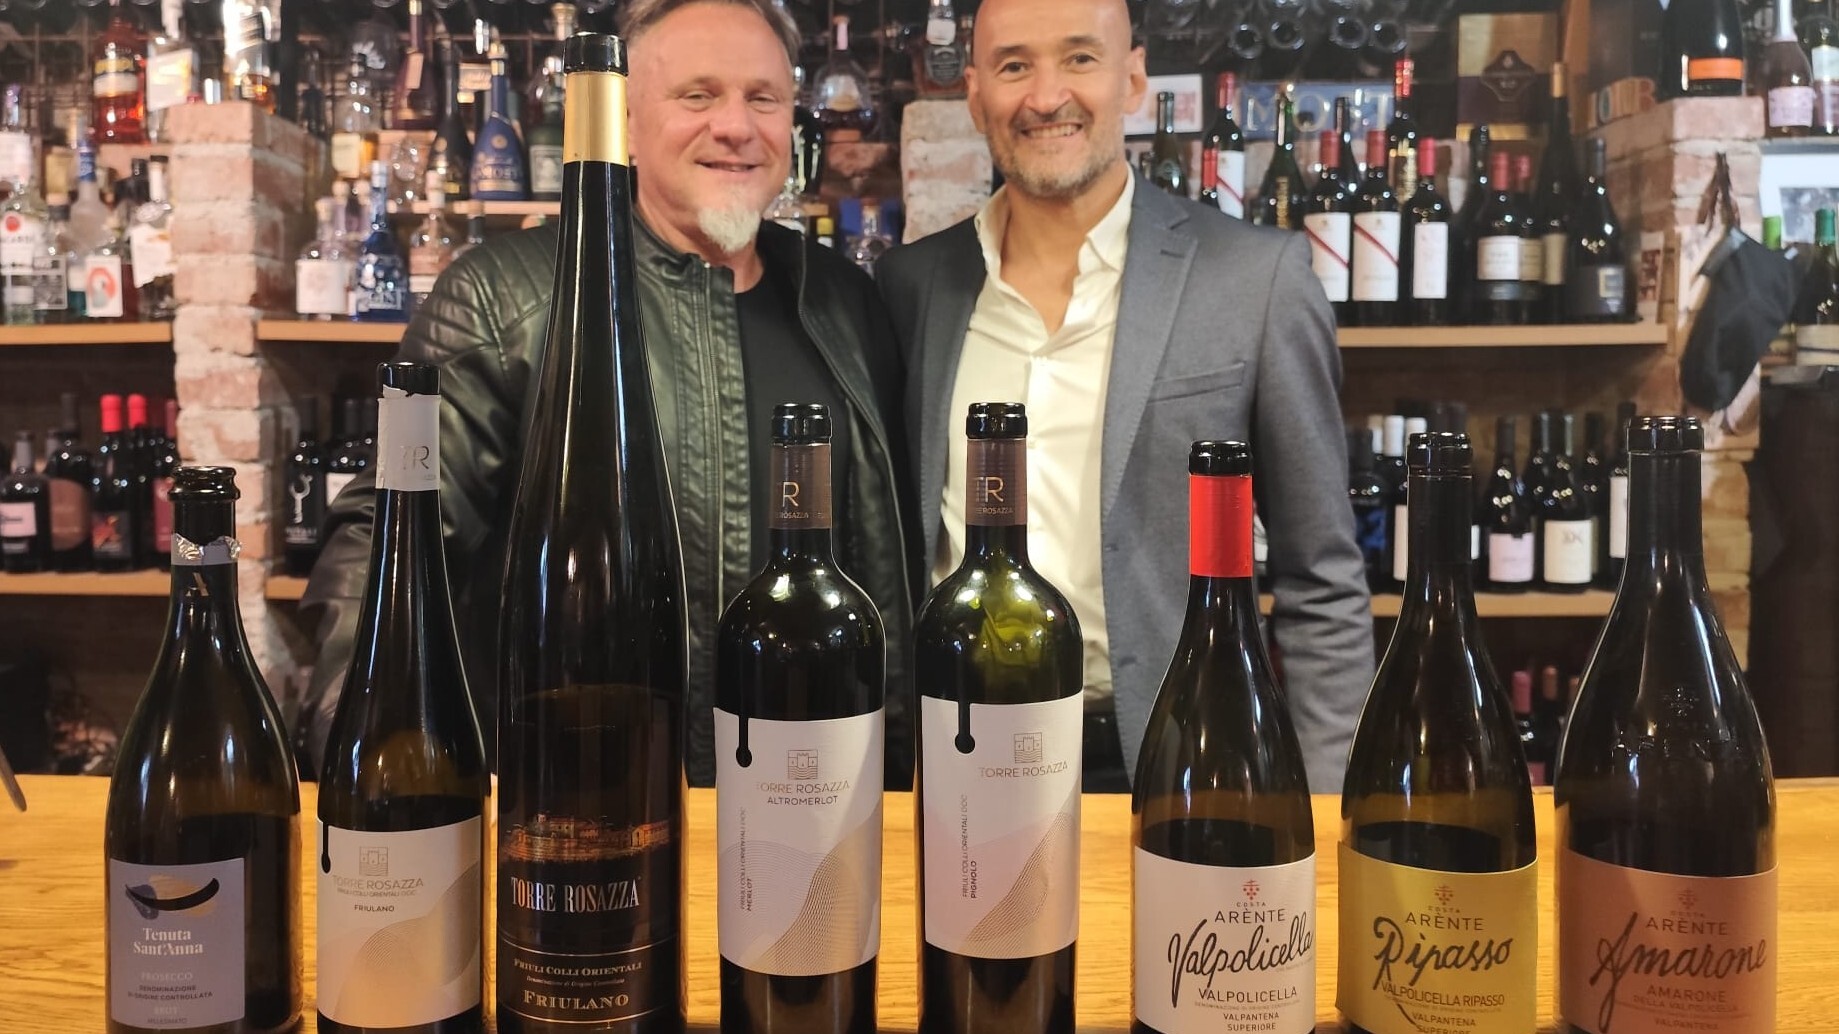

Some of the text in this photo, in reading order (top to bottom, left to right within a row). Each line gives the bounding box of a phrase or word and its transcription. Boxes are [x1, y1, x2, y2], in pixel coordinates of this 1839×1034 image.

[979, 760, 1068, 778] TORRE ROSAZZA
[796, 780, 850, 794] ROSAZZA
[767, 795, 838, 806] ALTROMERLOT
[332, 875, 424, 891] TORRE ROSAZZA
[510, 876, 640, 913] TORRE ROSAZZA
[354, 904, 395, 912] FRIULANO
[1215, 908, 1286, 924] ARÈNTE
[1405, 912, 1485, 931] ARÈNTE
[1645, 917, 1728, 936] ARÈNTE
[143, 928, 191, 941] Tenuta
[514, 958, 642, 976] FRIULI COLLI ORIENTALI
[1167, 911, 1313, 1008] Valpolicella
[141, 971, 193, 981] PROSECCO
[1372, 916, 1513, 1026] Ripasso
[1589, 911, 1767, 1034] Amarone
[160, 991, 213, 1000] CONTROLLATA
[524, 990, 629, 1010] FRIULANO
[1198, 986, 1297, 1003] VALPOLICELLA
[1381, 980, 1460, 1006] VALPOLICELLA
[1463, 994, 1505, 1007] RIPASSO
[1647, 984, 1726, 1003] AMARONE
[1223, 1011, 1279, 1021] VALPANTENA
[1412, 1011, 1476, 1026] VALPANTENA
[1227, 1022, 1276, 1032] SUPERIORE
